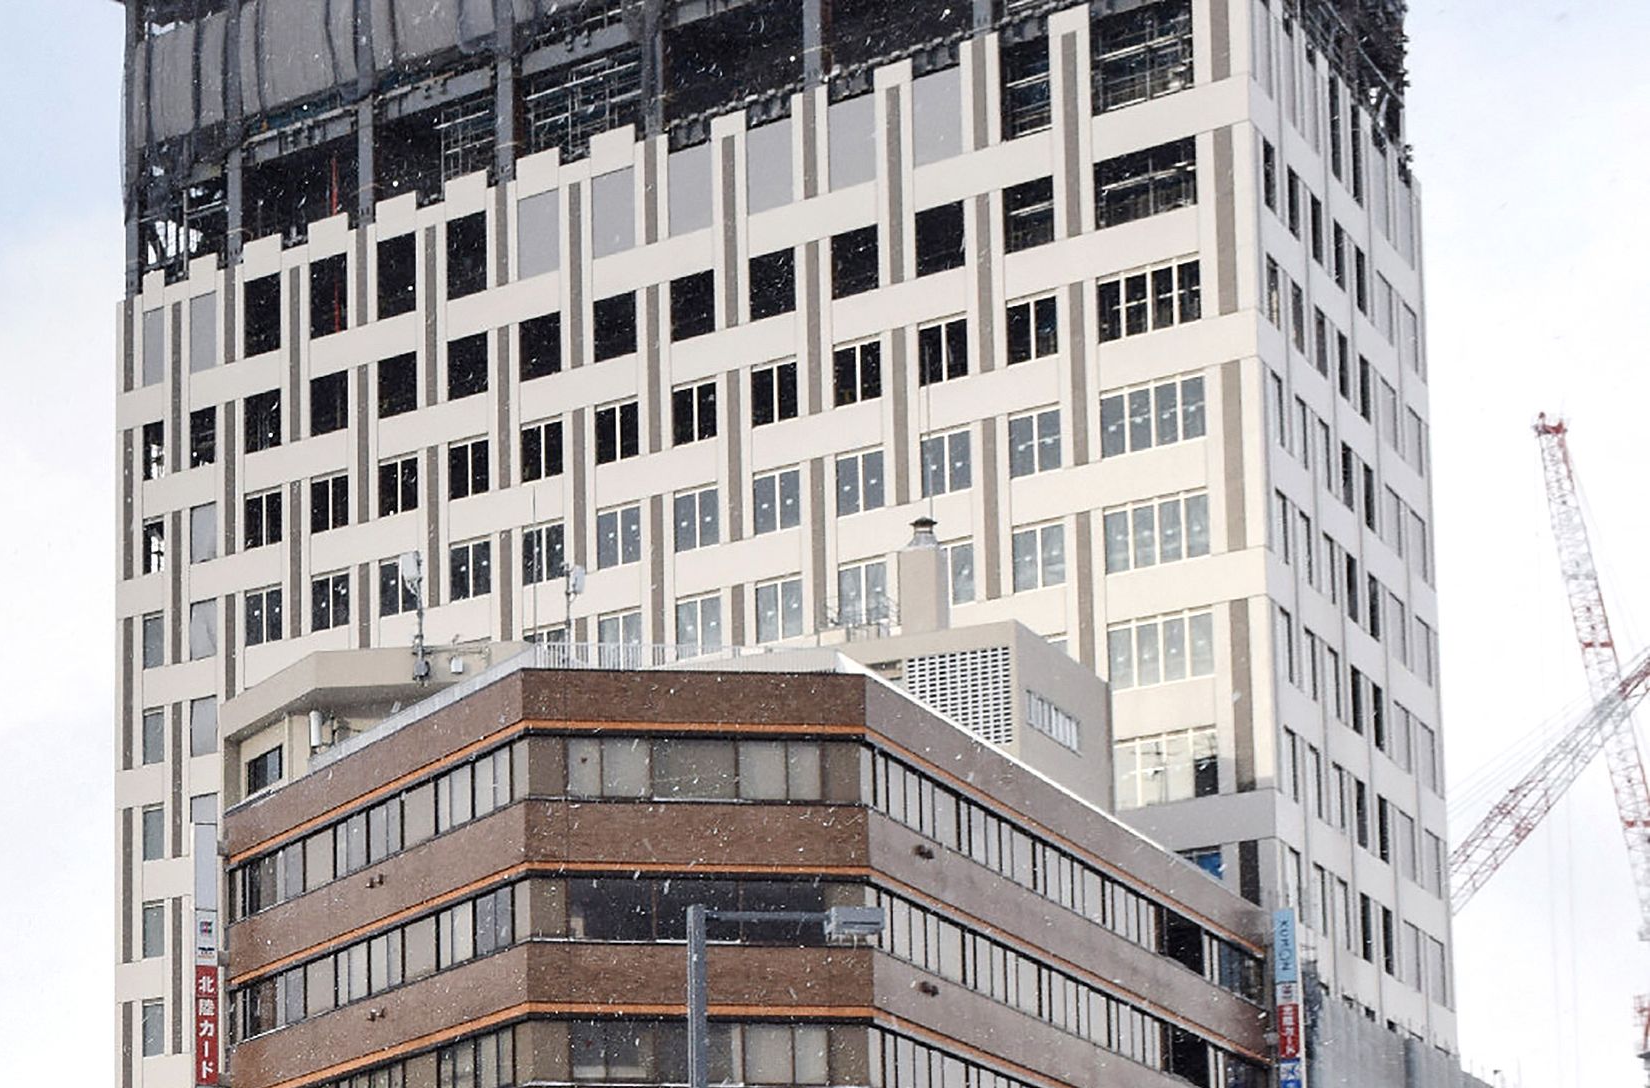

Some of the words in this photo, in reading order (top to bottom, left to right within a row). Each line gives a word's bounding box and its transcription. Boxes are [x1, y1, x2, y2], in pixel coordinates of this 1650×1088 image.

[198, 975, 215, 1079] 北陸カード
